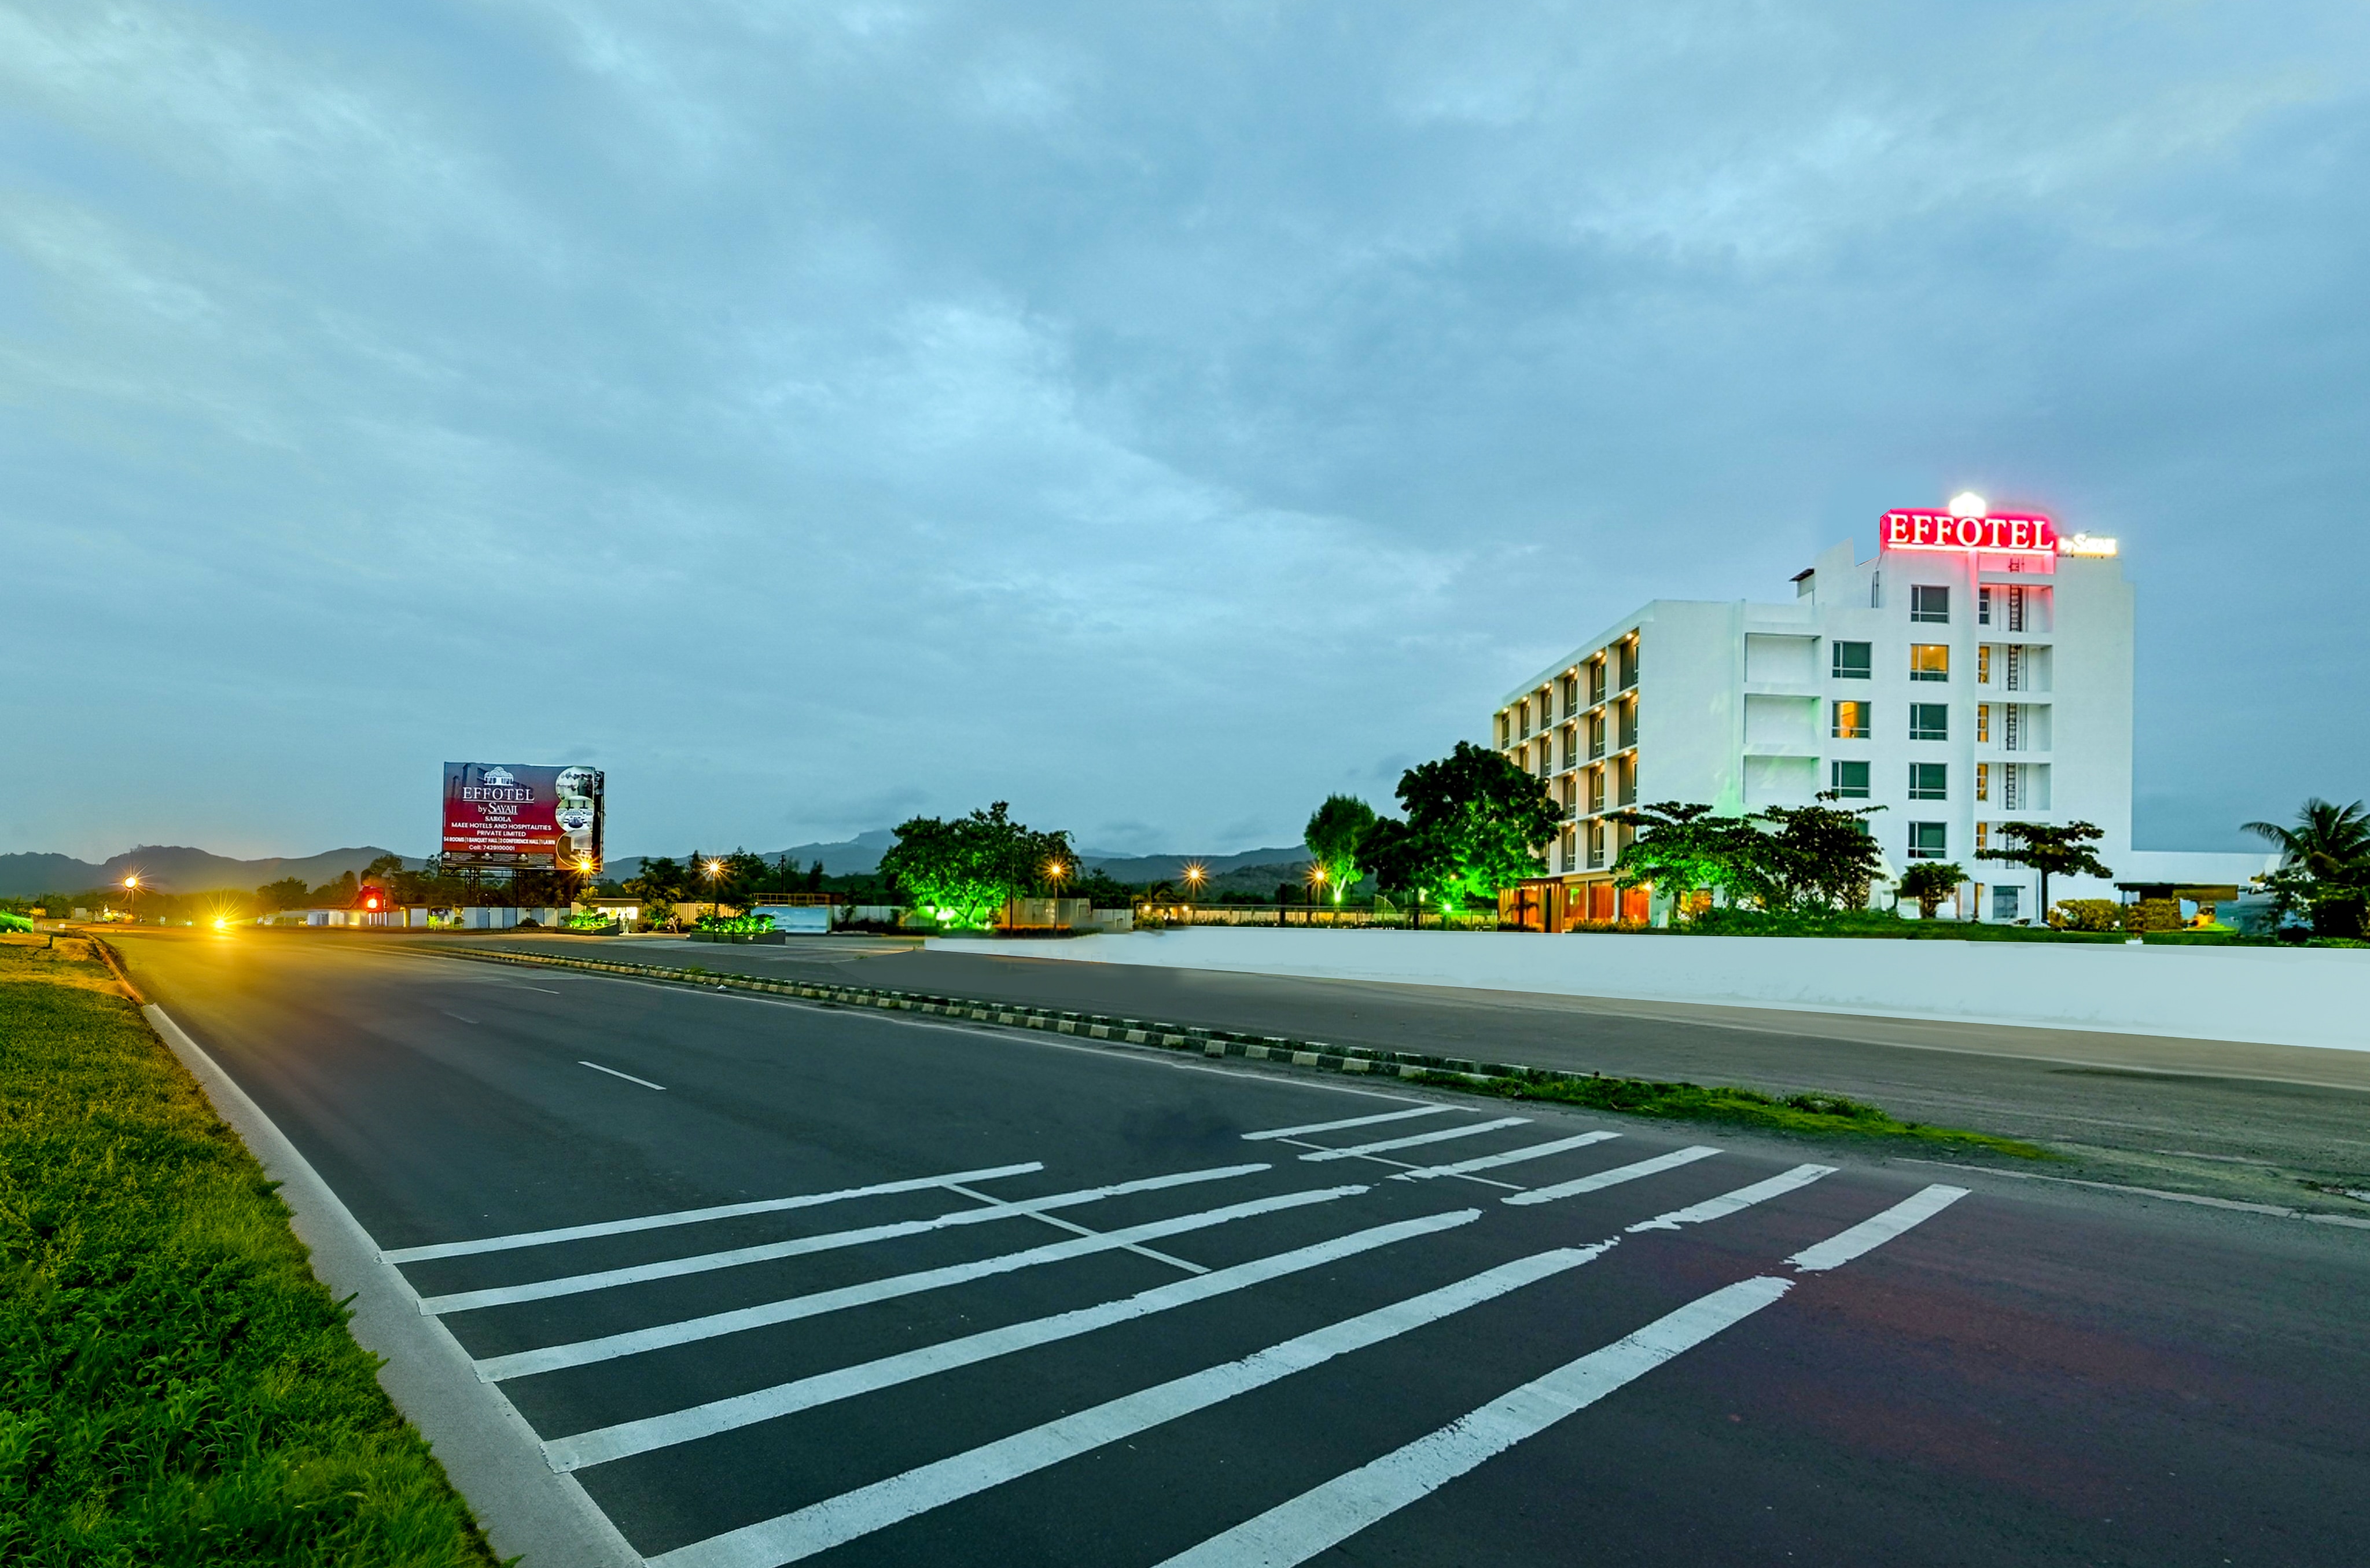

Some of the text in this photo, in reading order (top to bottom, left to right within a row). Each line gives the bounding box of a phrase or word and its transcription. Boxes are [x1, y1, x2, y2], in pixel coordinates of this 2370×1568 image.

[1887, 513, 2054, 549] EFFOTEL
[463, 787, 535, 801] EFFOTEL
[478, 805, 487, 814] by
